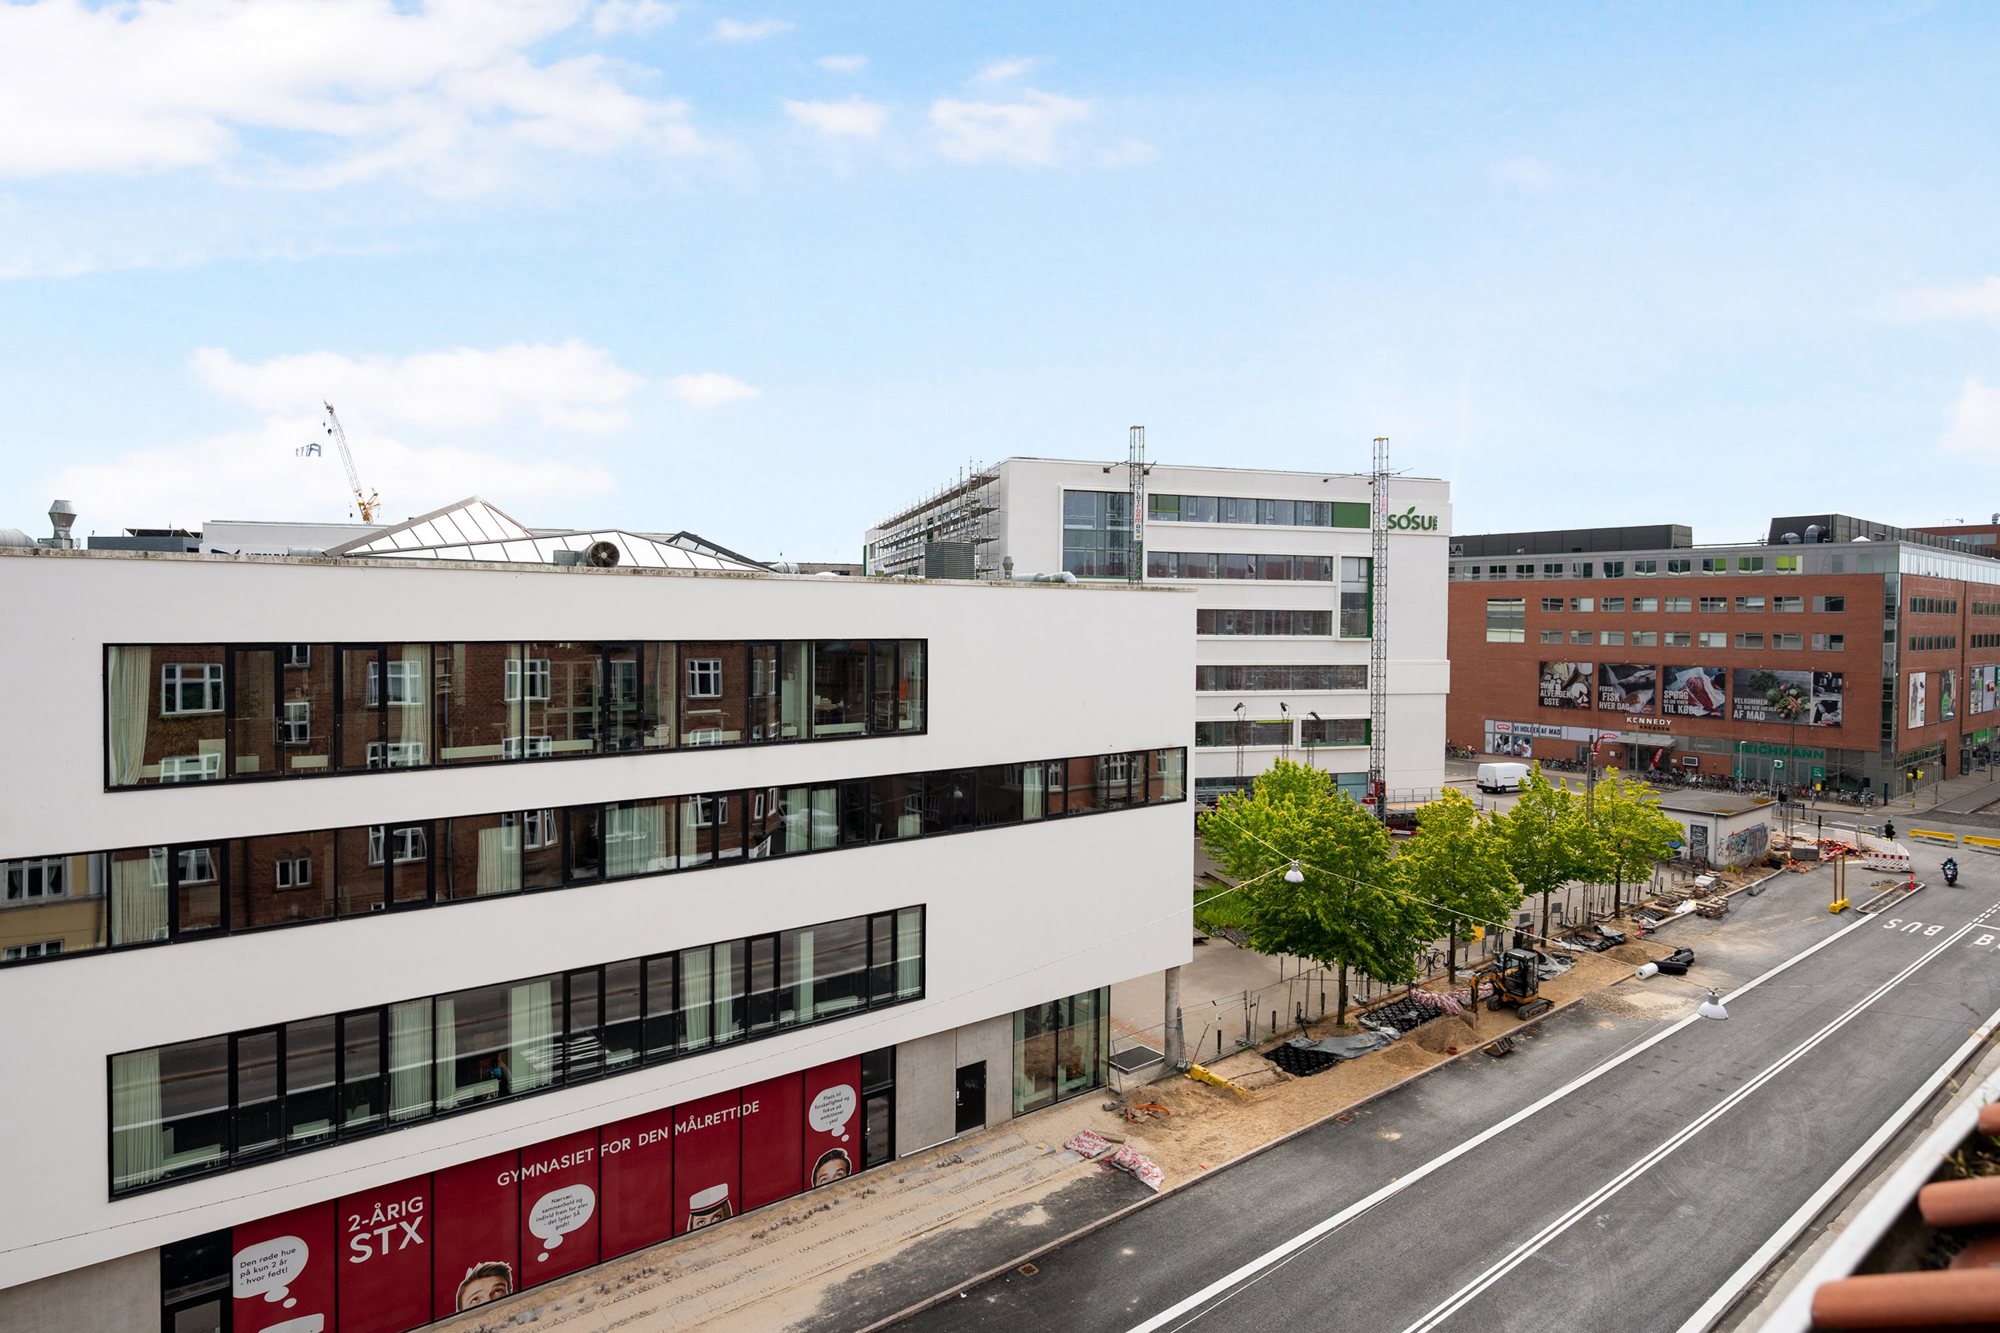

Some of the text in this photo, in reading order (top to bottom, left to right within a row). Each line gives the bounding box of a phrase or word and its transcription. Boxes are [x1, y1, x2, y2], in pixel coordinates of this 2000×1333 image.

[1599, 701, 1616, 710] HVER
[1602, 692, 1620, 702] FISK
[1664, 704, 1676, 714] TIL
[1733, 710, 1744, 720] AF
[1746, 711, 1766, 720] MAD
[1626, 716, 1672, 726] KENNEDY
[1735, 743, 1825, 760] DEICHMANN
[1882, 918, 1945, 936] BUS
[496, 1147, 595, 1187] GYMNASIET
[600, 1137, 631, 1157] FOR
[638, 1126, 669, 1147] DEN
[348, 1196, 424, 1233] 2-ÅRIG
[349, 1215, 425, 1264] STX
[240, 1248, 296, 1269] Den røde hue
[240, 1268, 251, 1279] på
[253, 1265, 269, 1274] kun
[279, 1258, 288, 1266] år
[246, 1274, 266, 1285] hvor
[268, 1266, 288, 1278] fedt!
